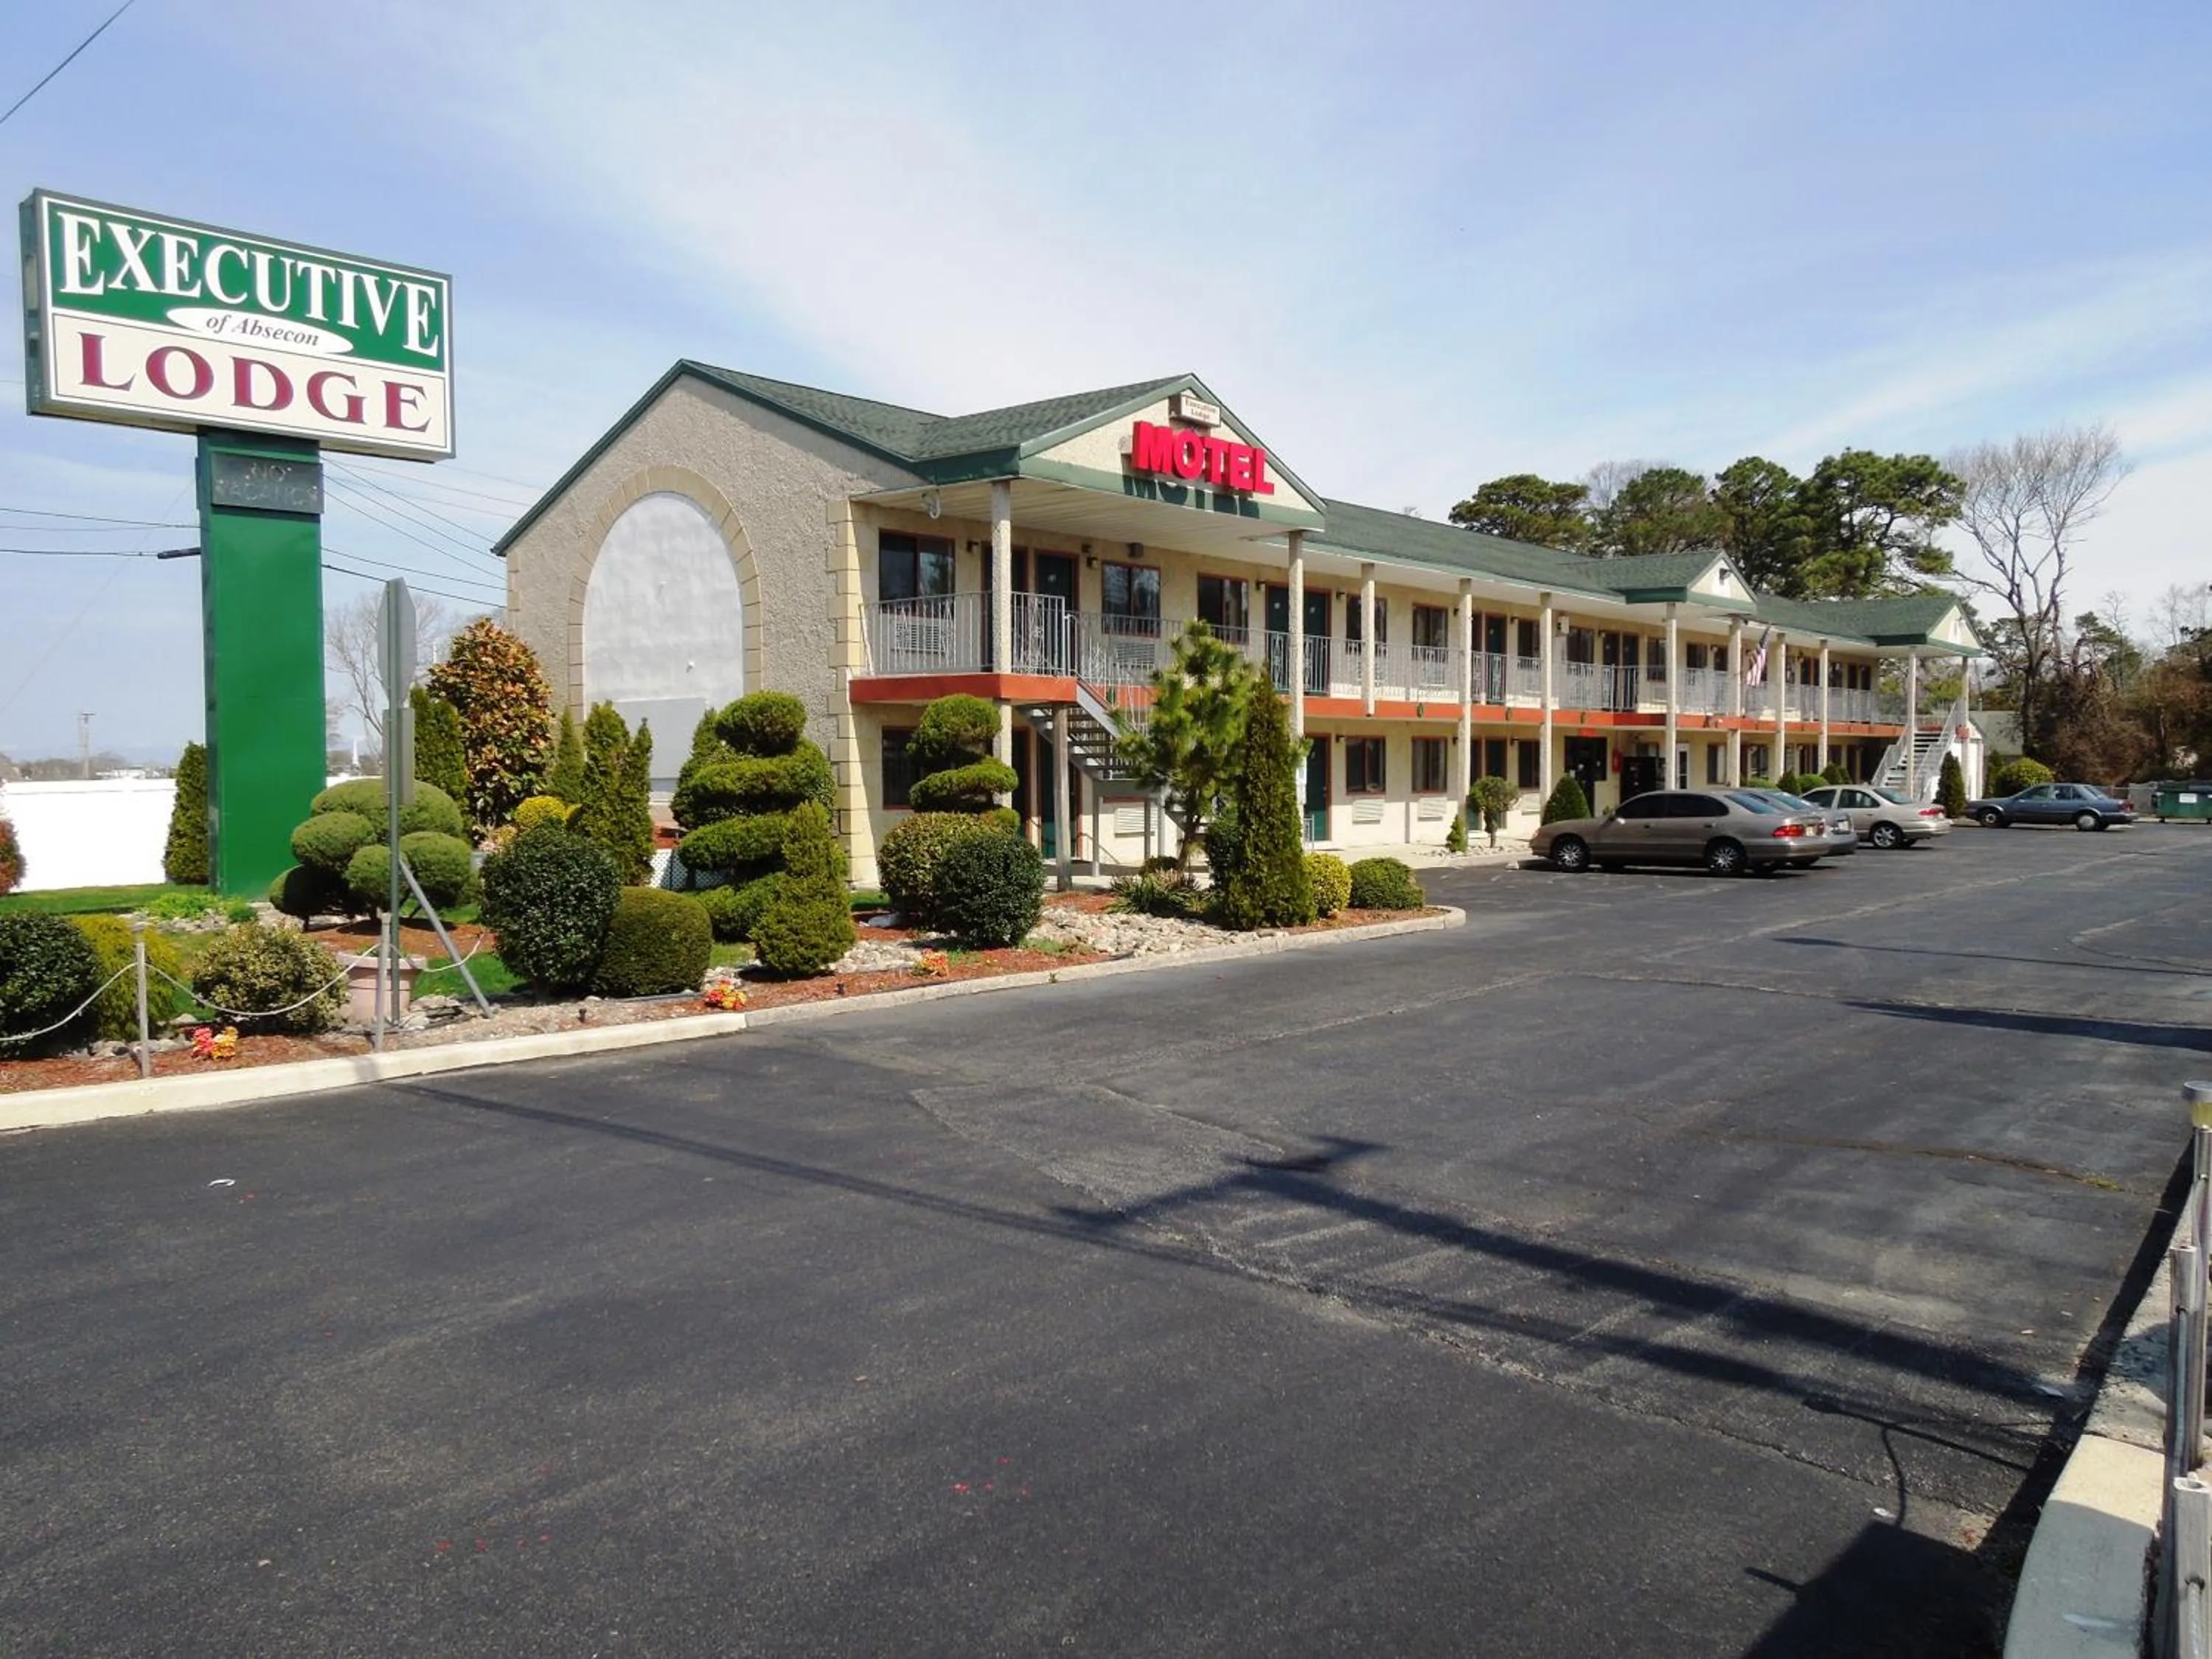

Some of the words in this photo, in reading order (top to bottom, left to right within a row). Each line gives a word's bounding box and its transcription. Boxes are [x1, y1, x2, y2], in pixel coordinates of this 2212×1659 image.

[58, 211, 439, 358] EXECUTIVE
[206, 314, 230, 334] of
[231, 317, 319, 347] Absecon
[77, 333, 432, 433] LODGE
[1133, 420, 1274, 495] MOTEL
